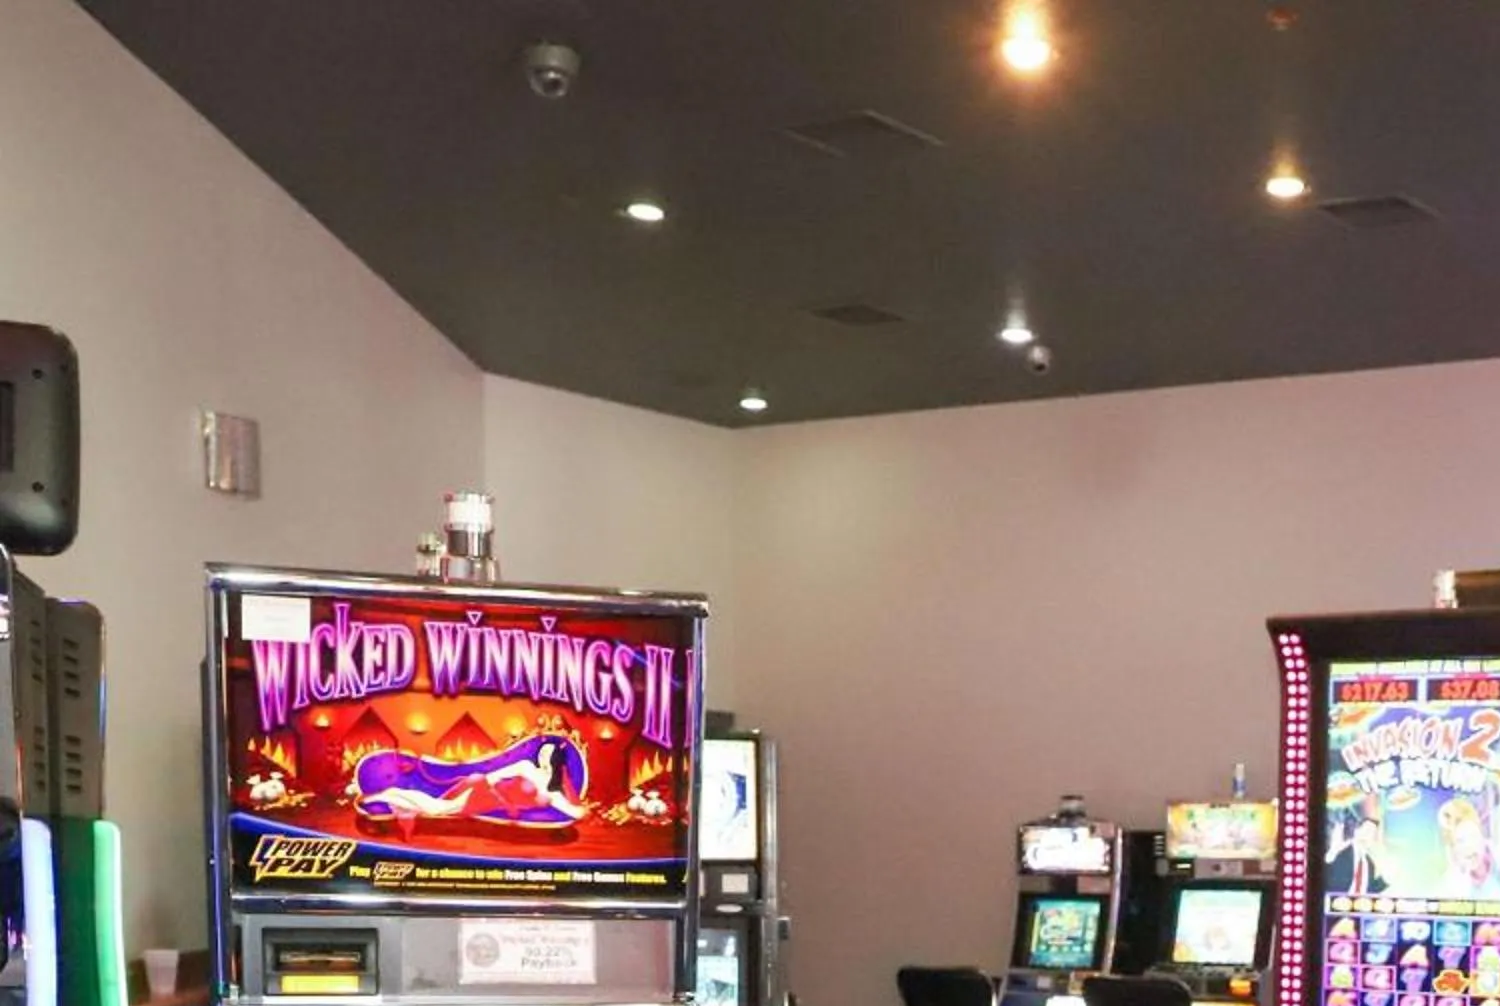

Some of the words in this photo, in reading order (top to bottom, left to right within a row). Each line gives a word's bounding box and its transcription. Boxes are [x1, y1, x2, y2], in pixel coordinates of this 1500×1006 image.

[252, 602, 415, 732] WICKED
[424, 611, 634, 723] WINNINGS
[1341, 716, 1464, 772] INVASION
[266, 858, 338, 874] PAY
[274, 839, 353, 857] POWER
